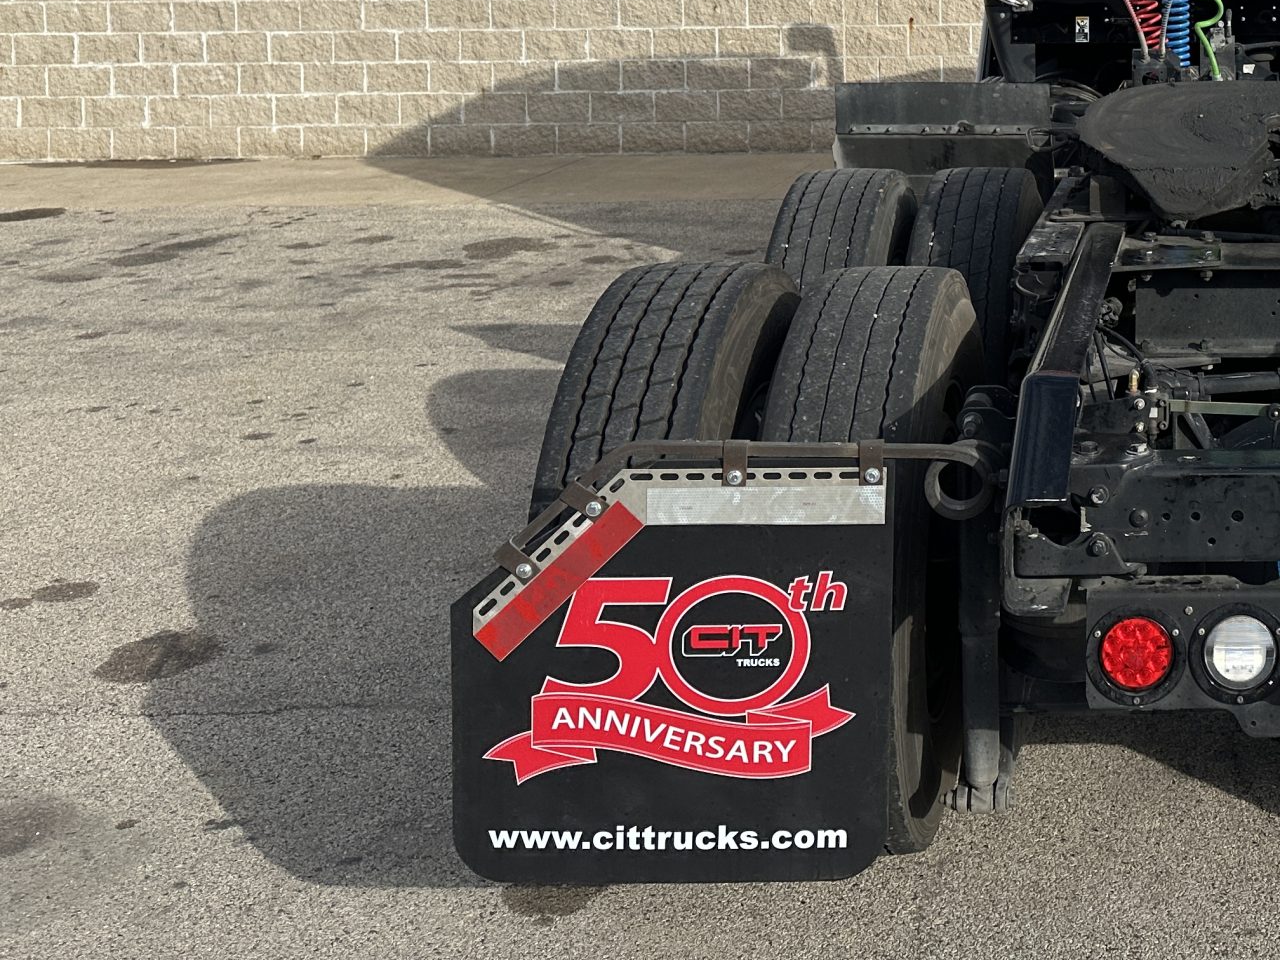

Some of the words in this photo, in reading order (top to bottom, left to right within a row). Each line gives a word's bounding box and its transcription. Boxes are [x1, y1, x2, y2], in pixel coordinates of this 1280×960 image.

[687, 624, 782, 652] CIT
[736, 658, 780, 667] TRUCKS
[551, 707, 797, 764] ANNIVERSARY
[488, 825, 848, 850] www.cittrucks.com
